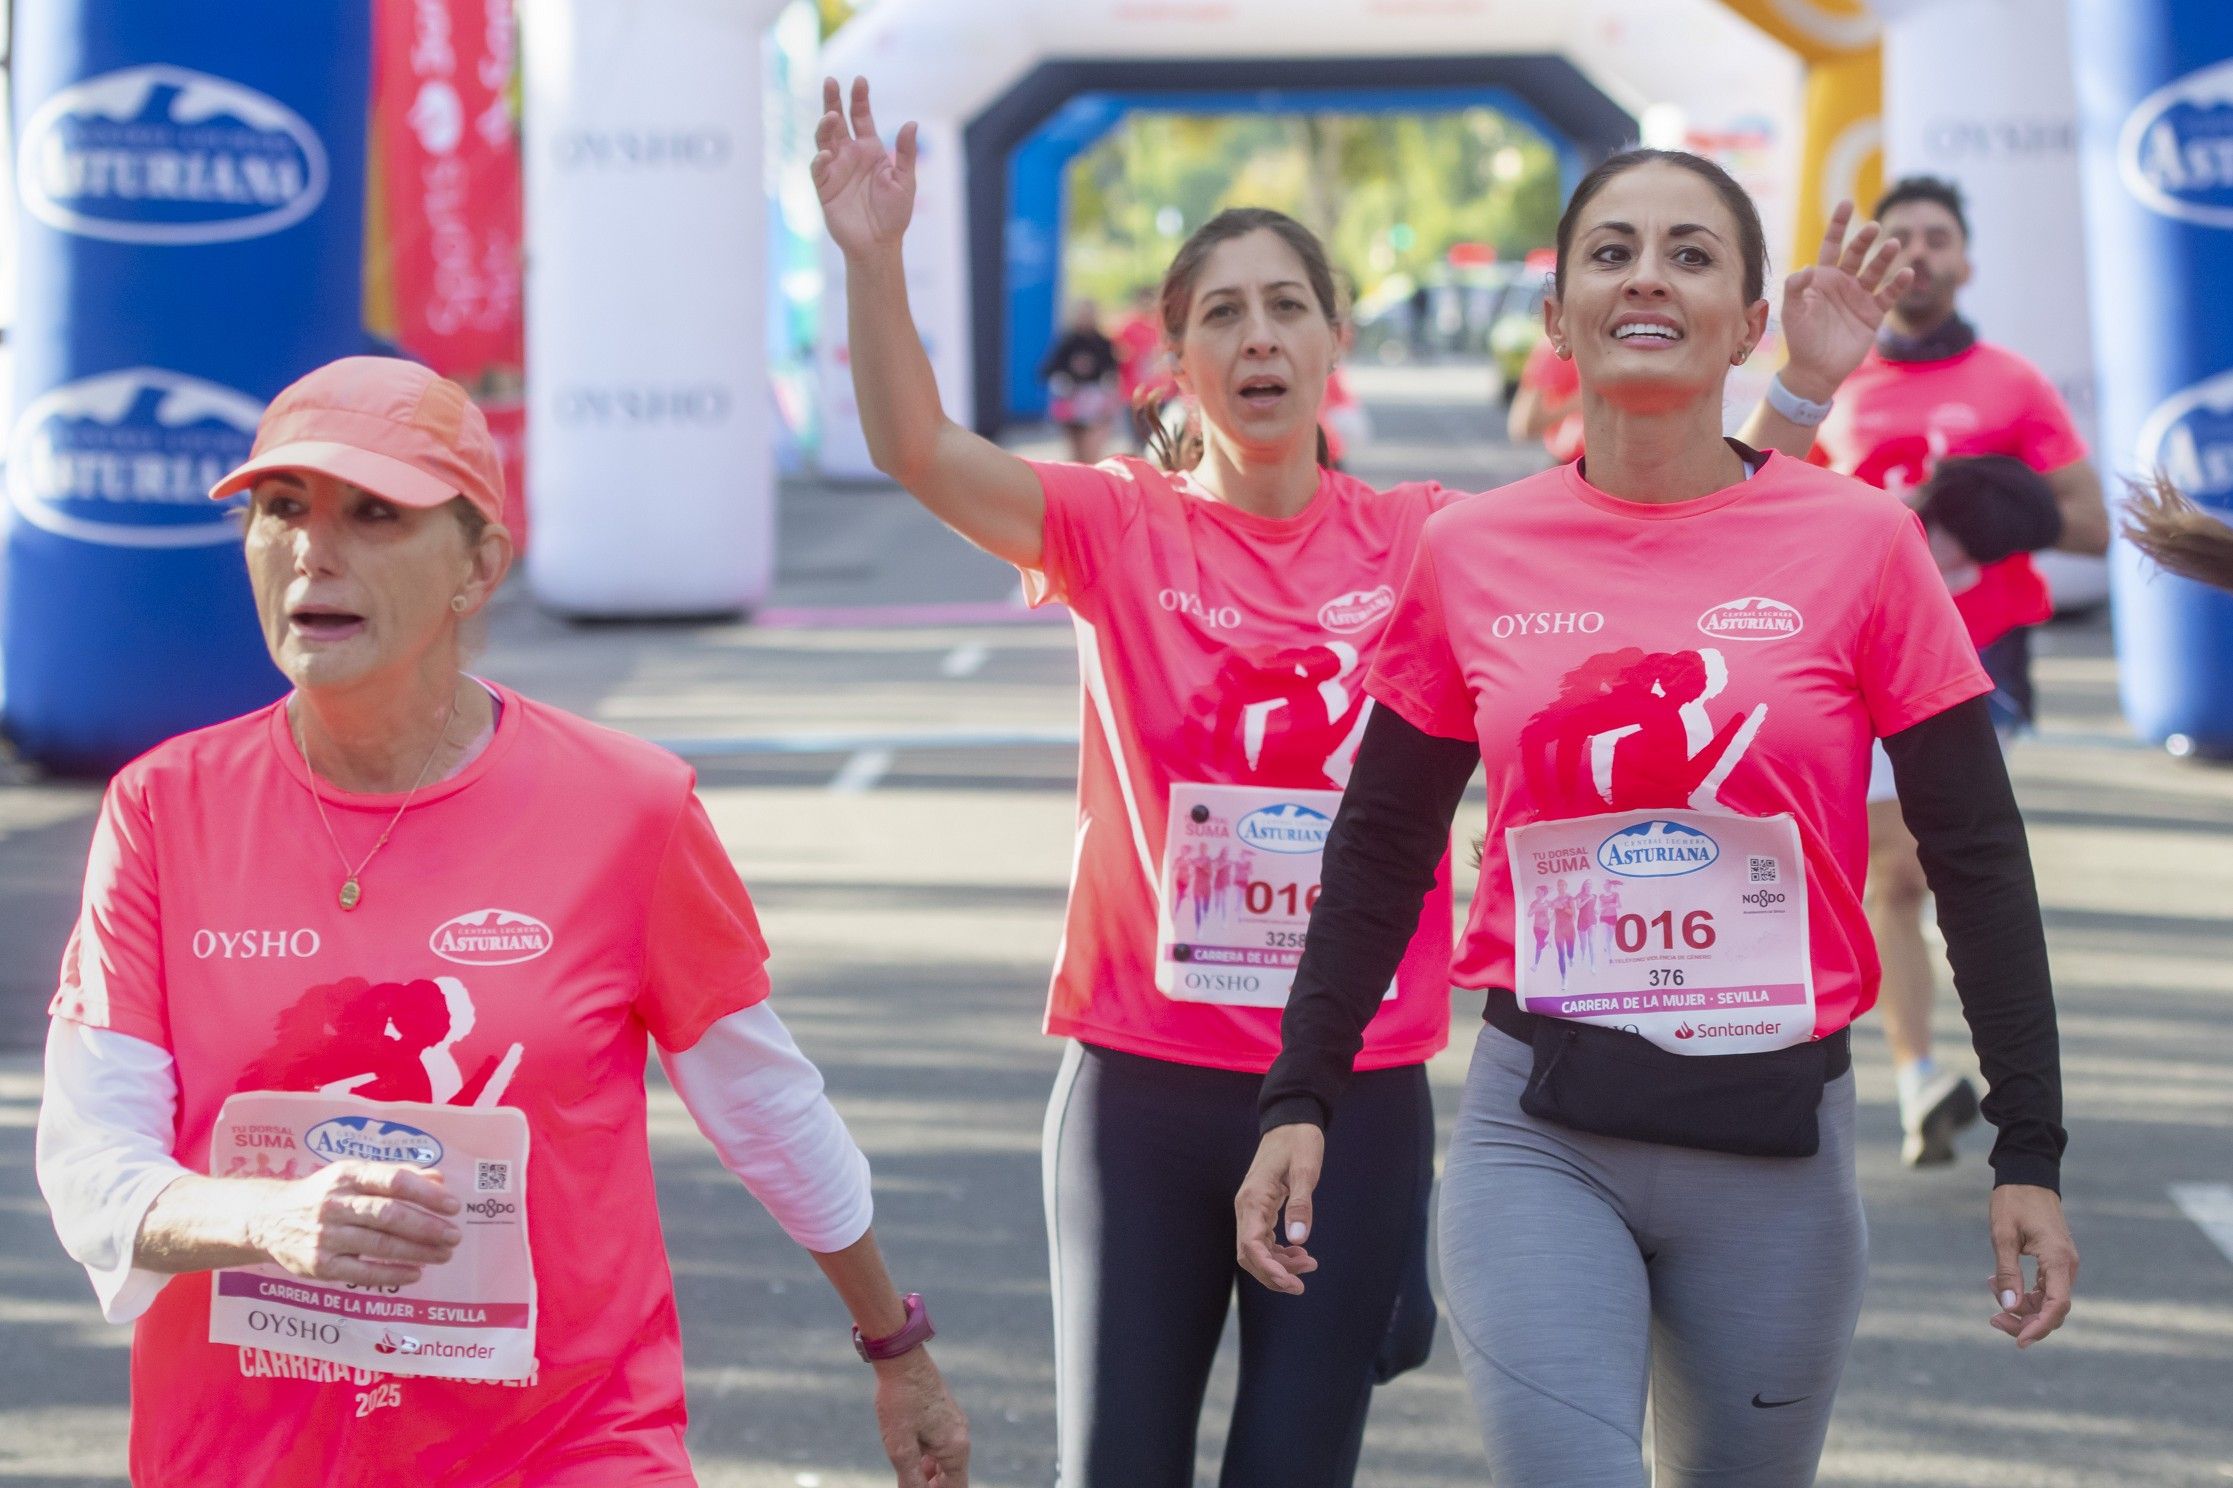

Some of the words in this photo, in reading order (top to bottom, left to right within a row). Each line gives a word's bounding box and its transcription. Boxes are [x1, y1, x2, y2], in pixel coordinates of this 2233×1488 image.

[1492, 611, 1604, 638] OYSHO
[1705, 613, 1795, 632] ASTURIANA
[1532, 852, 1546, 861] TU
[1546, 847, 1588, 859] DORSAL
[1607, 844, 1711, 867] ASTURIANA
[1537, 856, 1591, 875] SUMA
[440, 930, 544, 952] ASTURIANA
[1615, 910, 1717, 953] 016
[192, 928, 320, 959] OYSHO
[1185, 972, 1260, 992] OYSHO
[1649, 969, 1684, 987] 376
[1561, 997, 1619, 1014] CARRERA
[1623, 997, 1639, 1009] DE
[1643, 995, 1659, 1008] LA
[1663, 993, 1706, 1007] MUJER
[1717, 990, 1769, 1005] SEVILLA
[1697, 1022, 1781, 1039] Santander
[249, 1125, 294, 1136] DORSAL
[235, 1134, 296, 1150] SUMA
[258, 1281, 319, 1306] CARRERA
[323, 1293, 341, 1310] DE
[344, 1297, 362, 1313] LA
[365, 1299, 414, 1318] MUJER
[427, 1306, 487, 1323] SEVILLA
[248, 1310, 340, 1345] OYSHO
[355, 1383, 402, 1419] 2025
